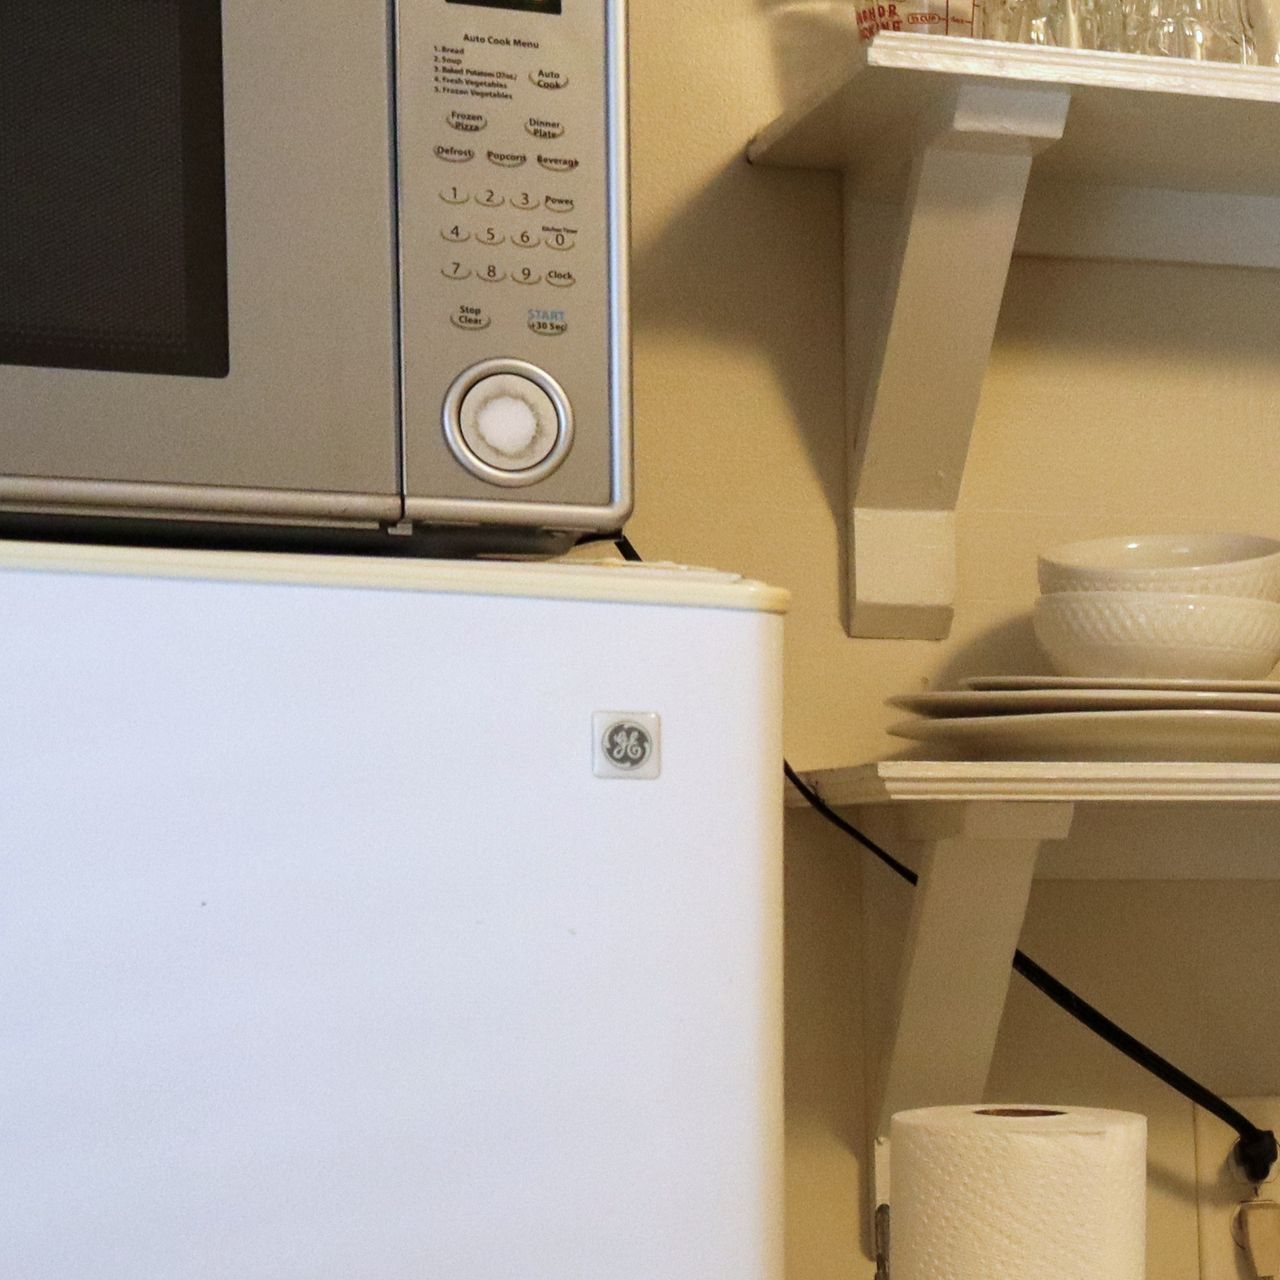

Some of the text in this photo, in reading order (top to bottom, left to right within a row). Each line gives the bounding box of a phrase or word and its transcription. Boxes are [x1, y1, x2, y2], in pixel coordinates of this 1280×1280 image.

[463, 33, 539, 49] Auto Cook Menu
[441, 46, 465, 54] Bread
[441, 56, 462, 65] Soup
[538, 69, 560, 79] Auto
[442, 76, 464, 84] Fresh
[464, 79, 507, 89] Vegetables
[537, 80, 561, 89] Cook
[442, 87, 469, 95] Frozen
[470, 90, 512, 99] Vegetables
[451, 110, 483, 121] Frozen
[455, 121, 480, 132] Pizza
[529, 118, 560, 129] Dinner
[533, 128, 557, 139] Plate
[437, 145, 472, 157] Defrost
[487, 150, 527, 162] Popcorn
[452, 187, 457, 199] 1
[486, 189, 494, 202] 2
[521, 193, 529, 205] 3
[545, 195, 573, 206] Power
[450, 225, 459, 238] 4
[487, 228, 495, 241] 5
[521, 231, 530, 243] 6
[555, 233, 565, 246] 0
[452, 262, 460, 275] 7
[487, 265, 496, 278] 8
[522, 267, 531, 280] 9
[548, 270, 573, 280] Clock
[460, 305, 481, 316] Stop
[528, 309, 565, 321] START
[459, 315, 482, 325] Clear
